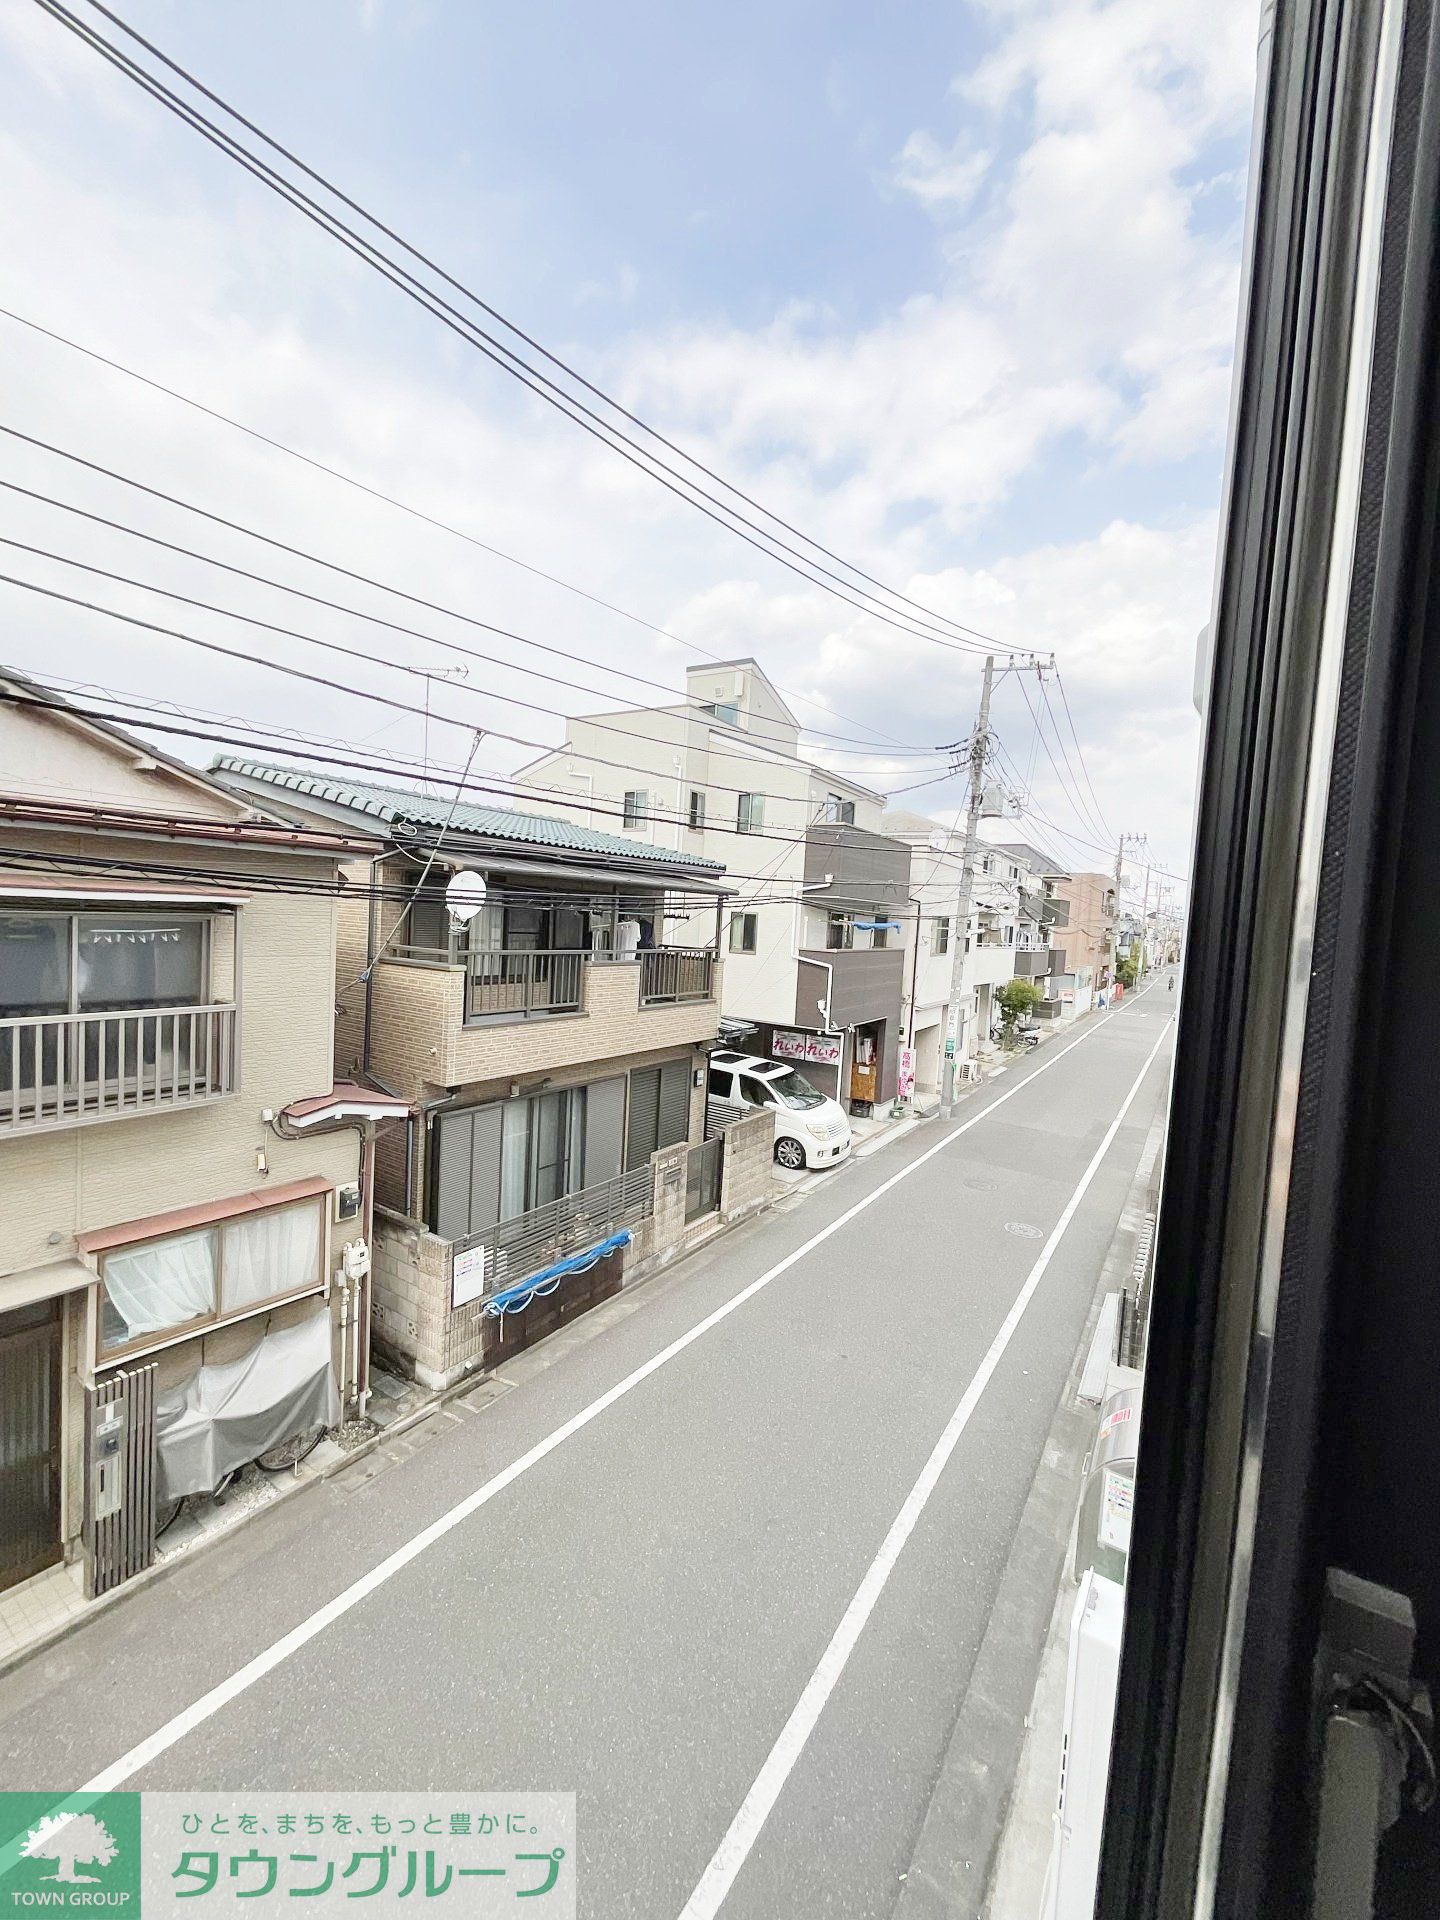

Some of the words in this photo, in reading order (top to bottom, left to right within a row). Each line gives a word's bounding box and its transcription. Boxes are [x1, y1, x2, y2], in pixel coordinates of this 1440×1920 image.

[774, 1038, 804, 1053] れいわ
[807, 1043, 839, 1059] れいわ
